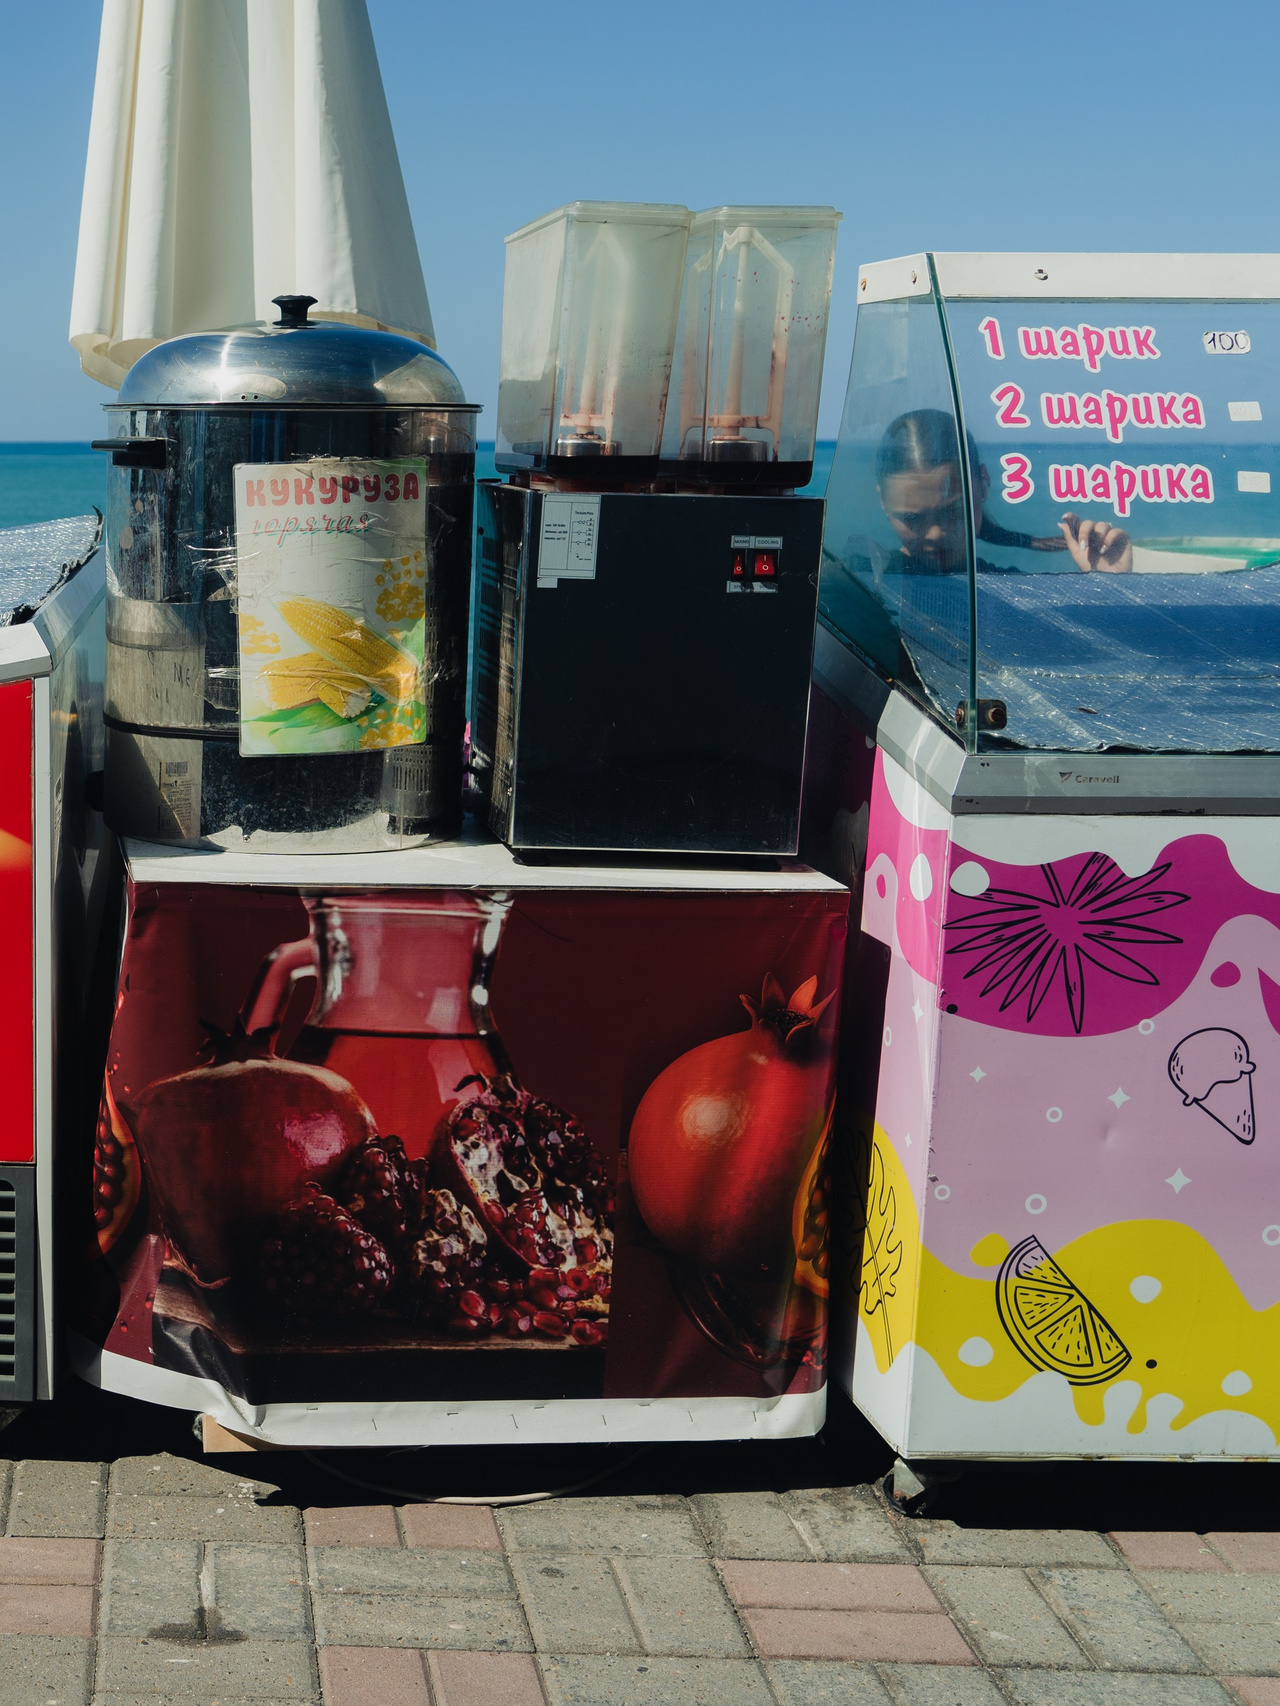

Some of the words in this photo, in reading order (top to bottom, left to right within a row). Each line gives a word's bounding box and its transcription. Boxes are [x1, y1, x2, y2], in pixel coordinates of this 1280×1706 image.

[982, 318, 1003, 358] 1
[1020, 325, 1159, 371] шарик
[1206, 332, 1249, 352] 100
[994, 384, 1029, 425] 2
[1044, 391, 1204, 442] шарика
[245, 472, 420, 507] КУКУРУЗА
[1003, 454, 1033, 500] 3
[1052, 463, 1213, 516] шарика
[1075, 774, 1120, 784] Caravell
